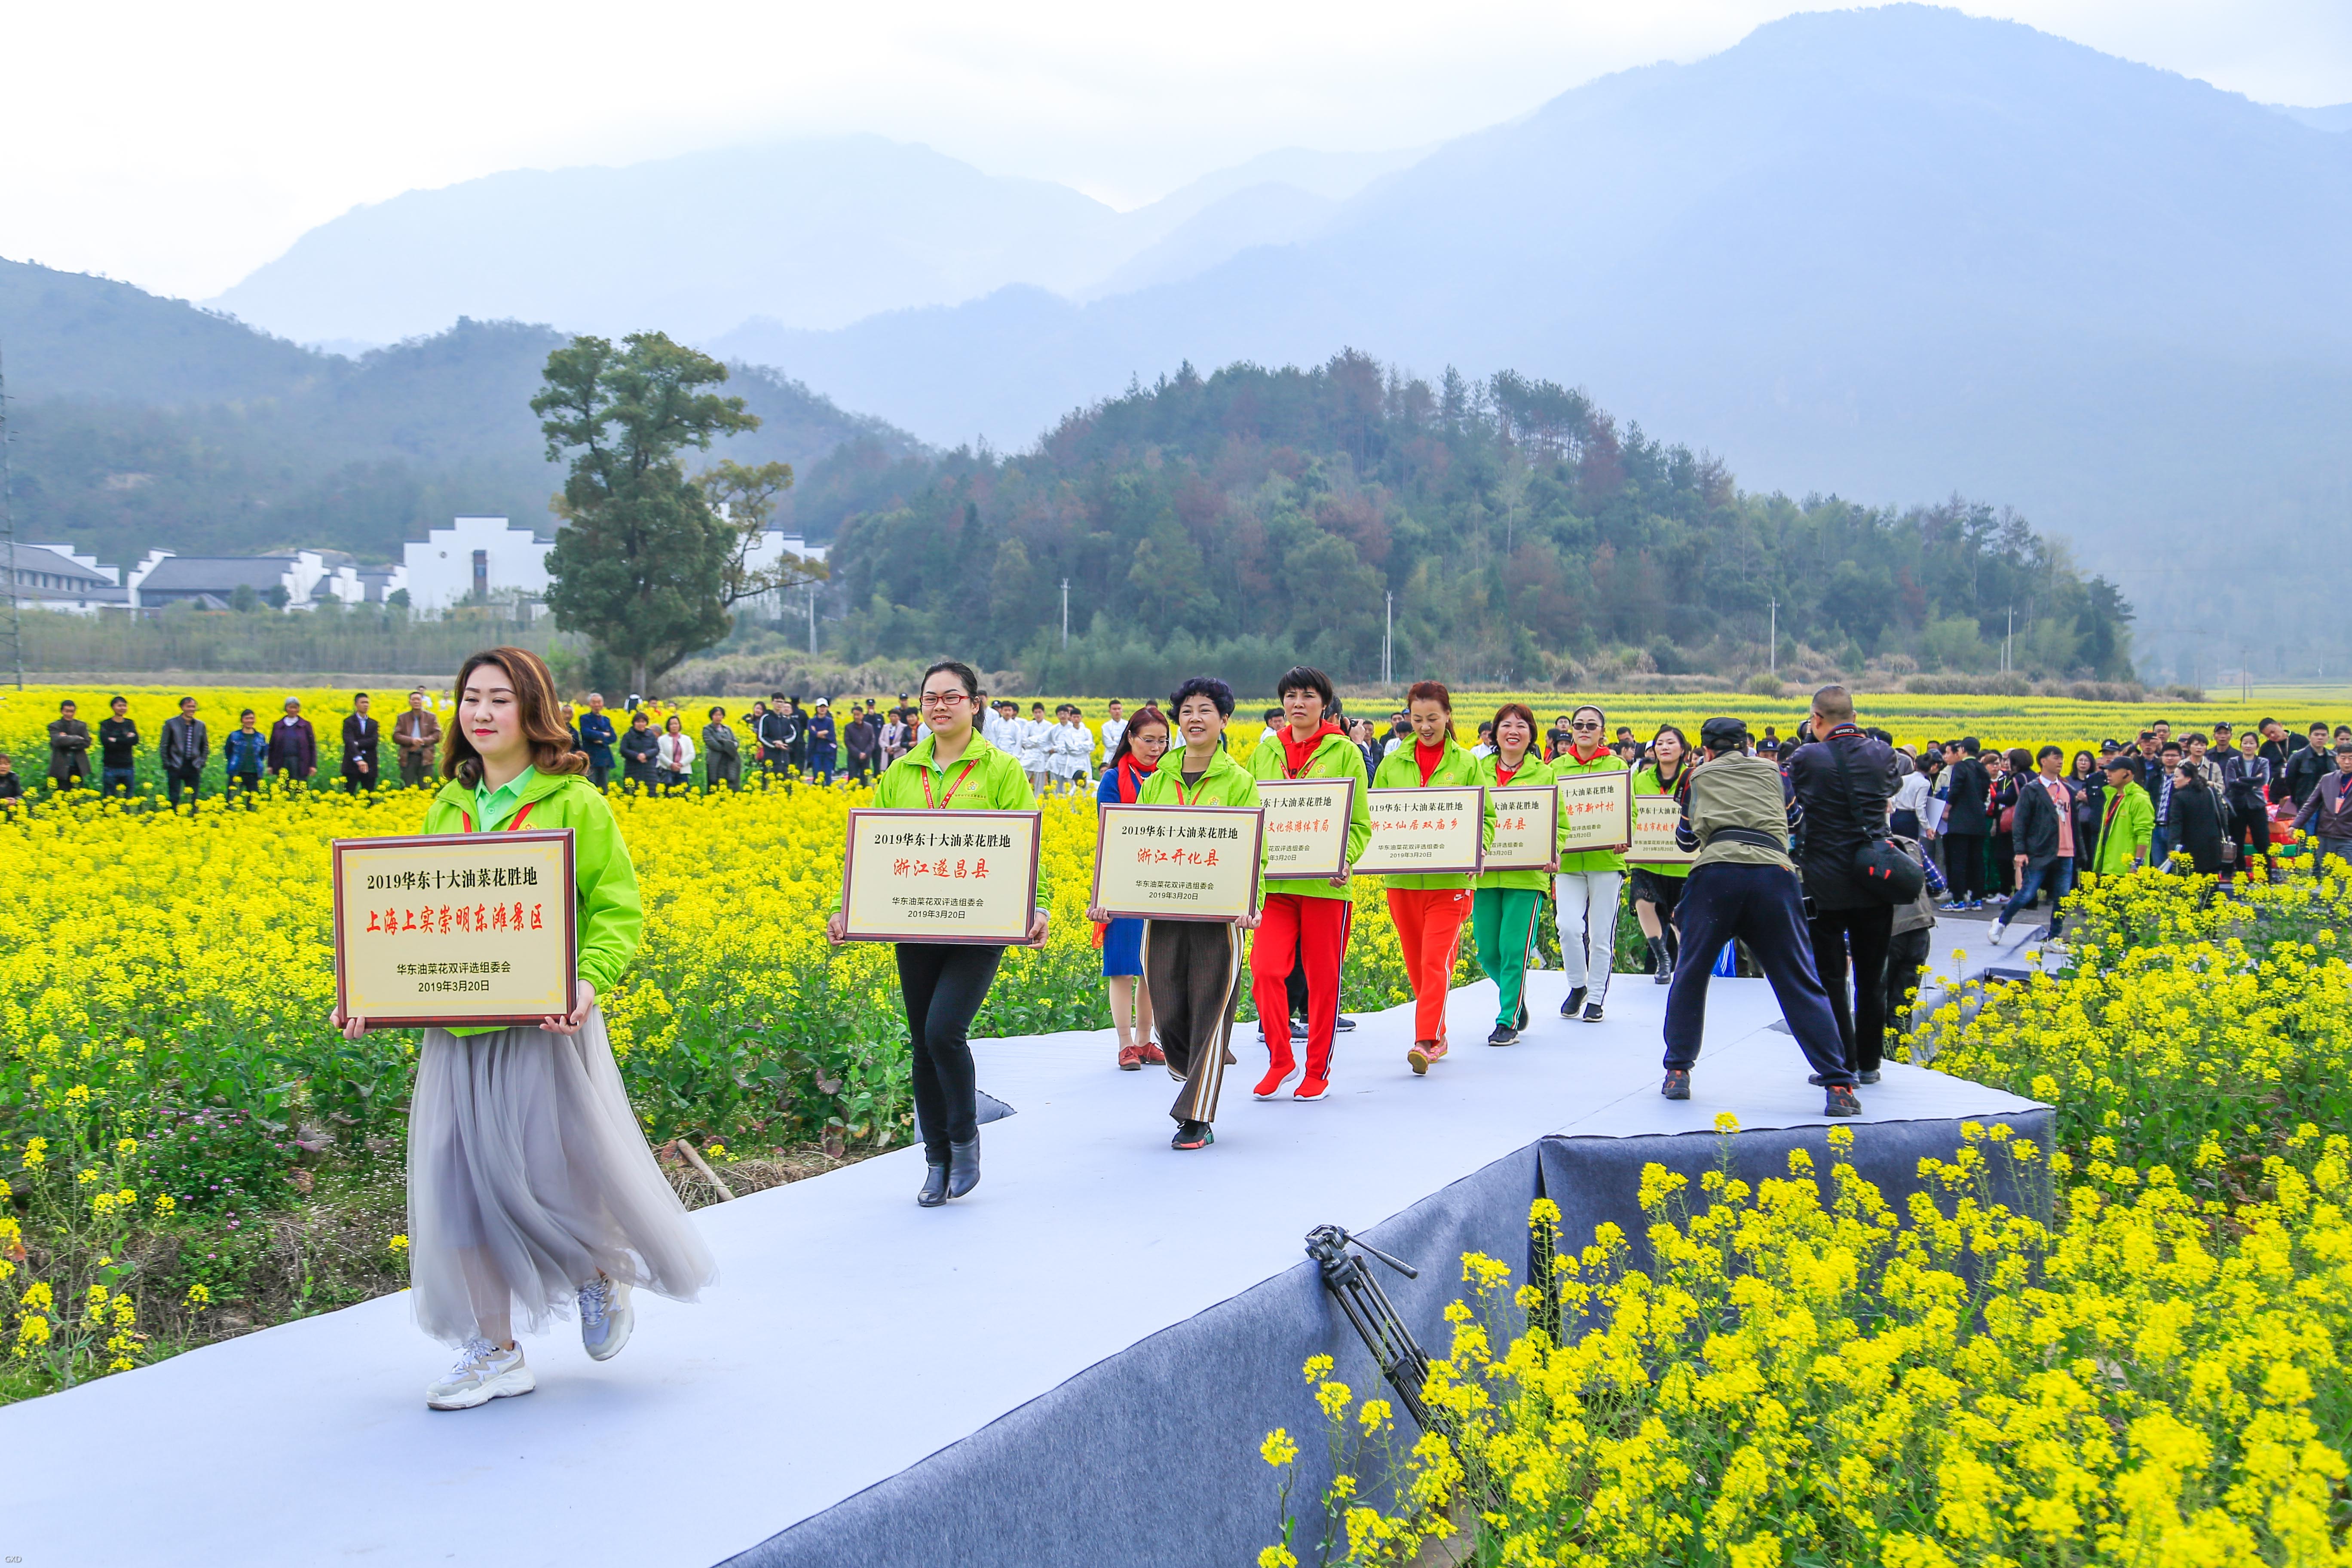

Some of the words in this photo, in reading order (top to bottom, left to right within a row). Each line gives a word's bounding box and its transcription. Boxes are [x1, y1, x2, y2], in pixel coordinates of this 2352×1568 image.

[1122, 825, 1238, 839] 2019华东十大油菜花胜地
[1264, 819, 1329, 833] 文化旅游体育局
[874, 833, 1011, 848] 2019华东十大油菜花胜地
[1137, 847, 1219, 866] 浙江开化县
[893, 858, 990, 879] 浙江遂昌县
[367, 866, 538, 890] 2019华东十大油菜花胜地
[1136, 880, 1214, 890] 华东油菜花双评选组委会
[892, 897, 984, 907] 华东油菜花双评选组委会
[1149, 891, 1198, 900] 2019年3月20日
[366, 902, 543, 936] 上海上实崇明东滩景区
[908, 910, 965, 919] 2019年3月20日
[397, 961, 511, 975] 华东油菜花双评选组委会
[418, 980, 490, 992] 2019年3月20日
